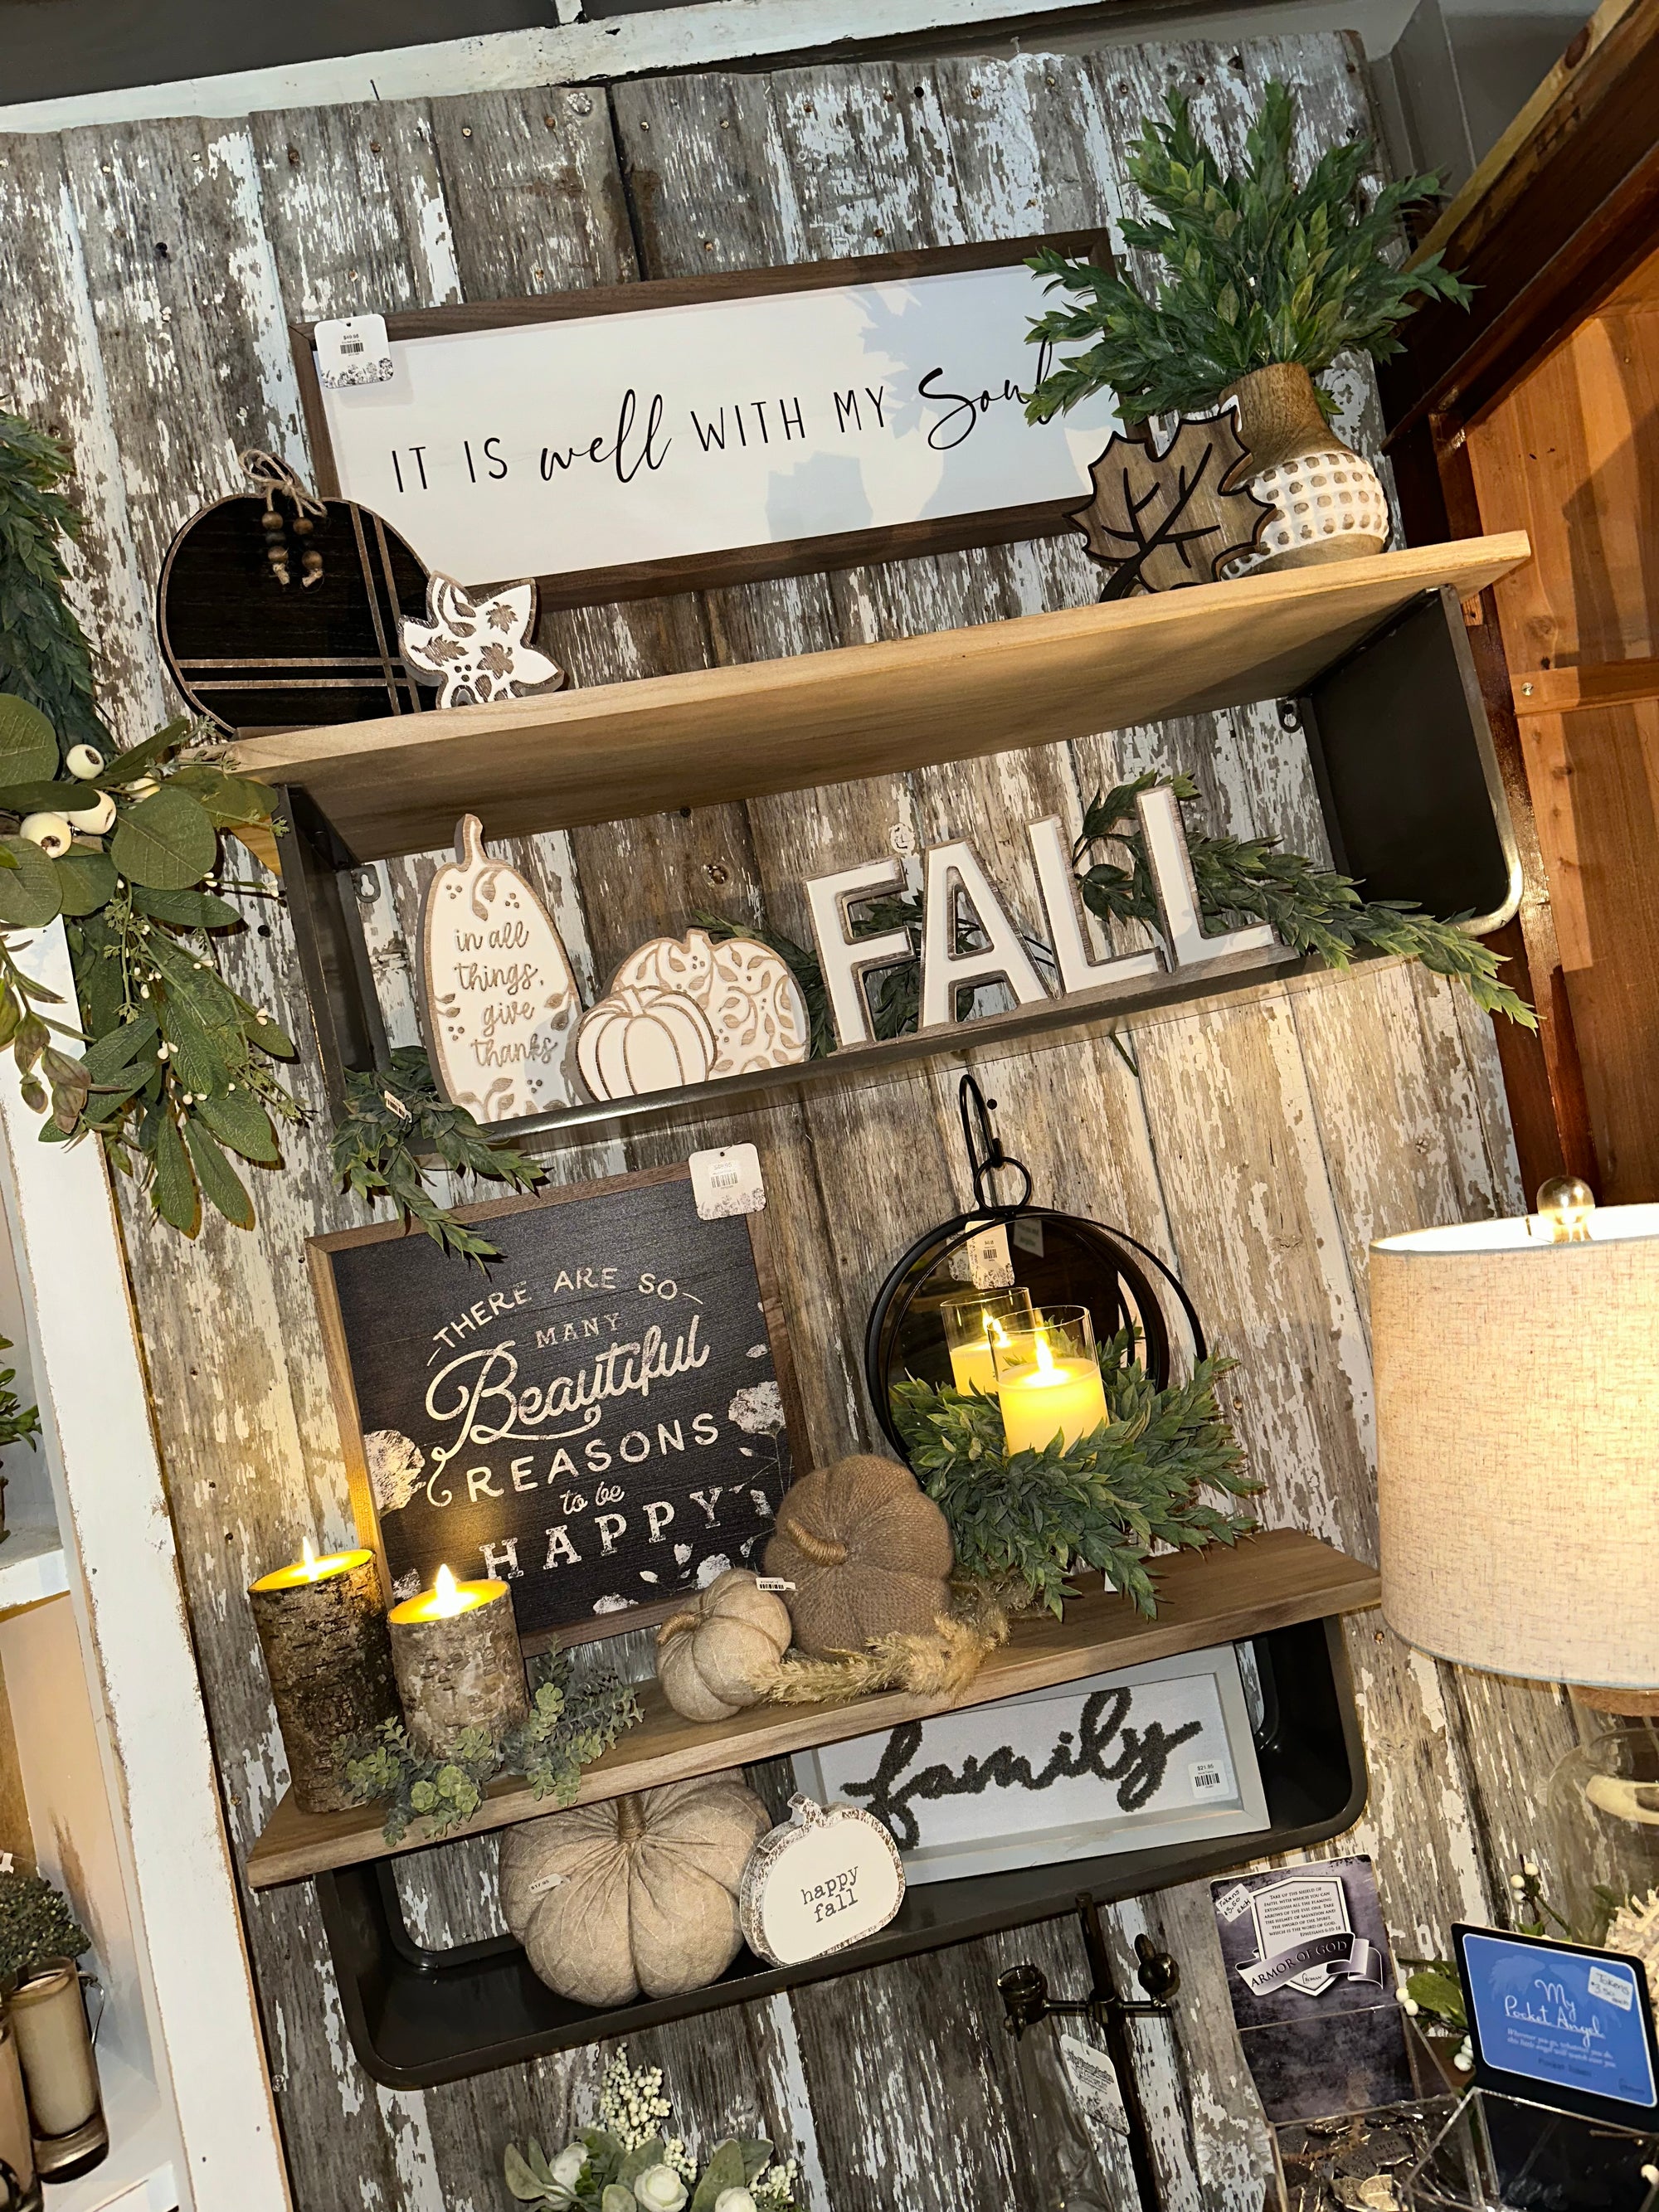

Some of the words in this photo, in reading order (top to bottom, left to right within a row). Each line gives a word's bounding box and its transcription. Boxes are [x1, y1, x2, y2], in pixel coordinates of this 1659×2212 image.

[392, 445, 428, 493] IT
[464, 437, 508, 484] IS
[540, 388, 673, 484] well
[690, 396, 806, 452] WITH
[833, 385, 885, 434] MY
[455, 929, 483, 952] in
[489, 921, 529, 949] all
[803, 784, 1278, 1047] FALL
[482, 1001, 535, 1037] give
[470, 1033, 558, 1067] thanks
[432, 1281, 532, 1350] THERE
[553, 1267, 618, 1294] ARE
[638, 1272, 679, 1300] SO
[536, 1312, 621, 1349] MANY
[426, 1314, 710, 1468] Beautiful
[467, 1412, 719, 1503] REASONS
[561, 1490, 588, 1516] to
[595, 1482, 625, 1511] be
[479, 1486, 723, 1580] HAPPY
[839, 1686, 1204, 1850] family
[800, 1865, 859, 1905] happy
[814, 1888, 859, 1923] fall
[1219, 1889, 1240, 1908] Tokens
[1237, 1898, 1251, 1914] EACH
[1251, 1957, 1296, 1987] ARMOR
[1296, 1950, 1312, 1962] OF
[1316, 1941, 1347, 1956] GOD
[1505, 1995, 1552, 2024] Pocket
[1558, 2005, 1606, 2048] Angel
[1535, 1979, 1575, 2022] My
